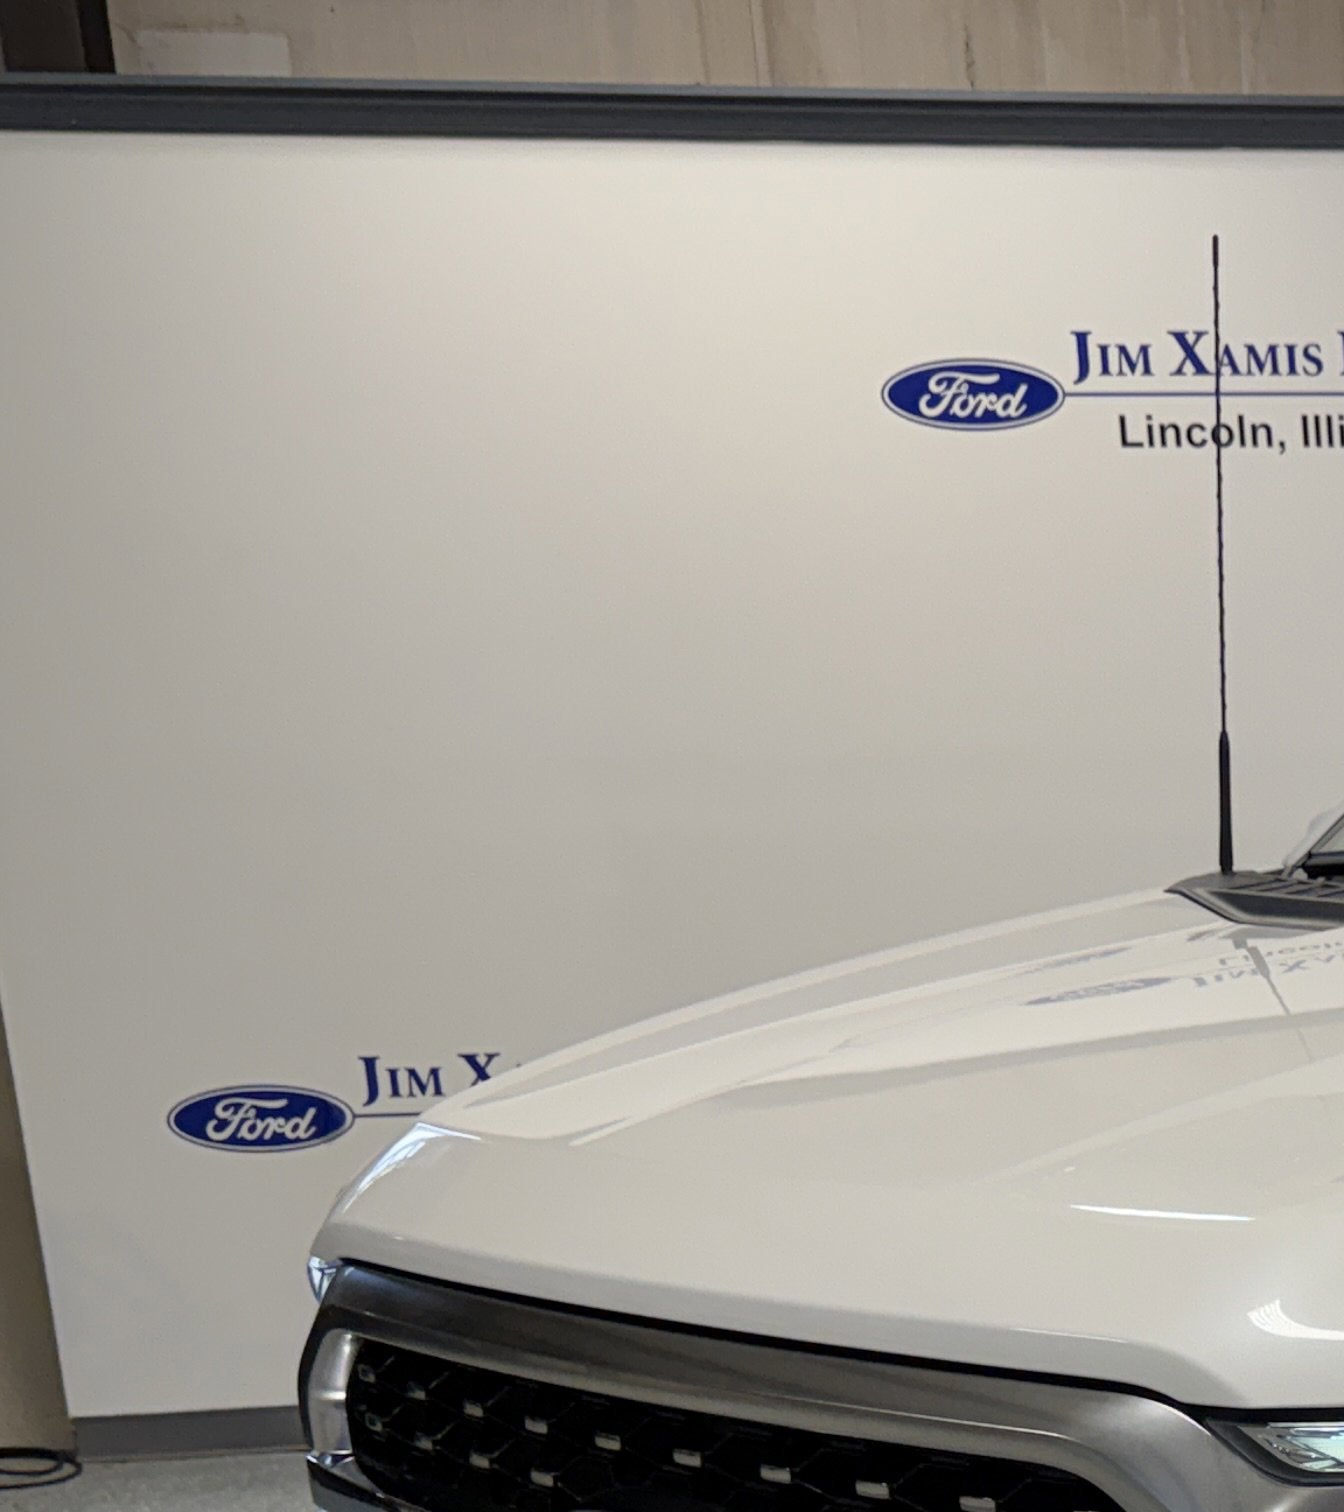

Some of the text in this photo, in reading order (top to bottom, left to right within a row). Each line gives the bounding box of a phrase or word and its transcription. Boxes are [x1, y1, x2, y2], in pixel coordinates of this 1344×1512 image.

[1070, 330, 1154, 384] JIM
[1167, 330, 1324, 377] XAMIS
[917, 372, 1029, 420] Ford
[1119, 414, 1287, 454] Lincoln,
[358, 1056, 446, 1107] JIM
[205, 1096, 319, 1142] Ford
